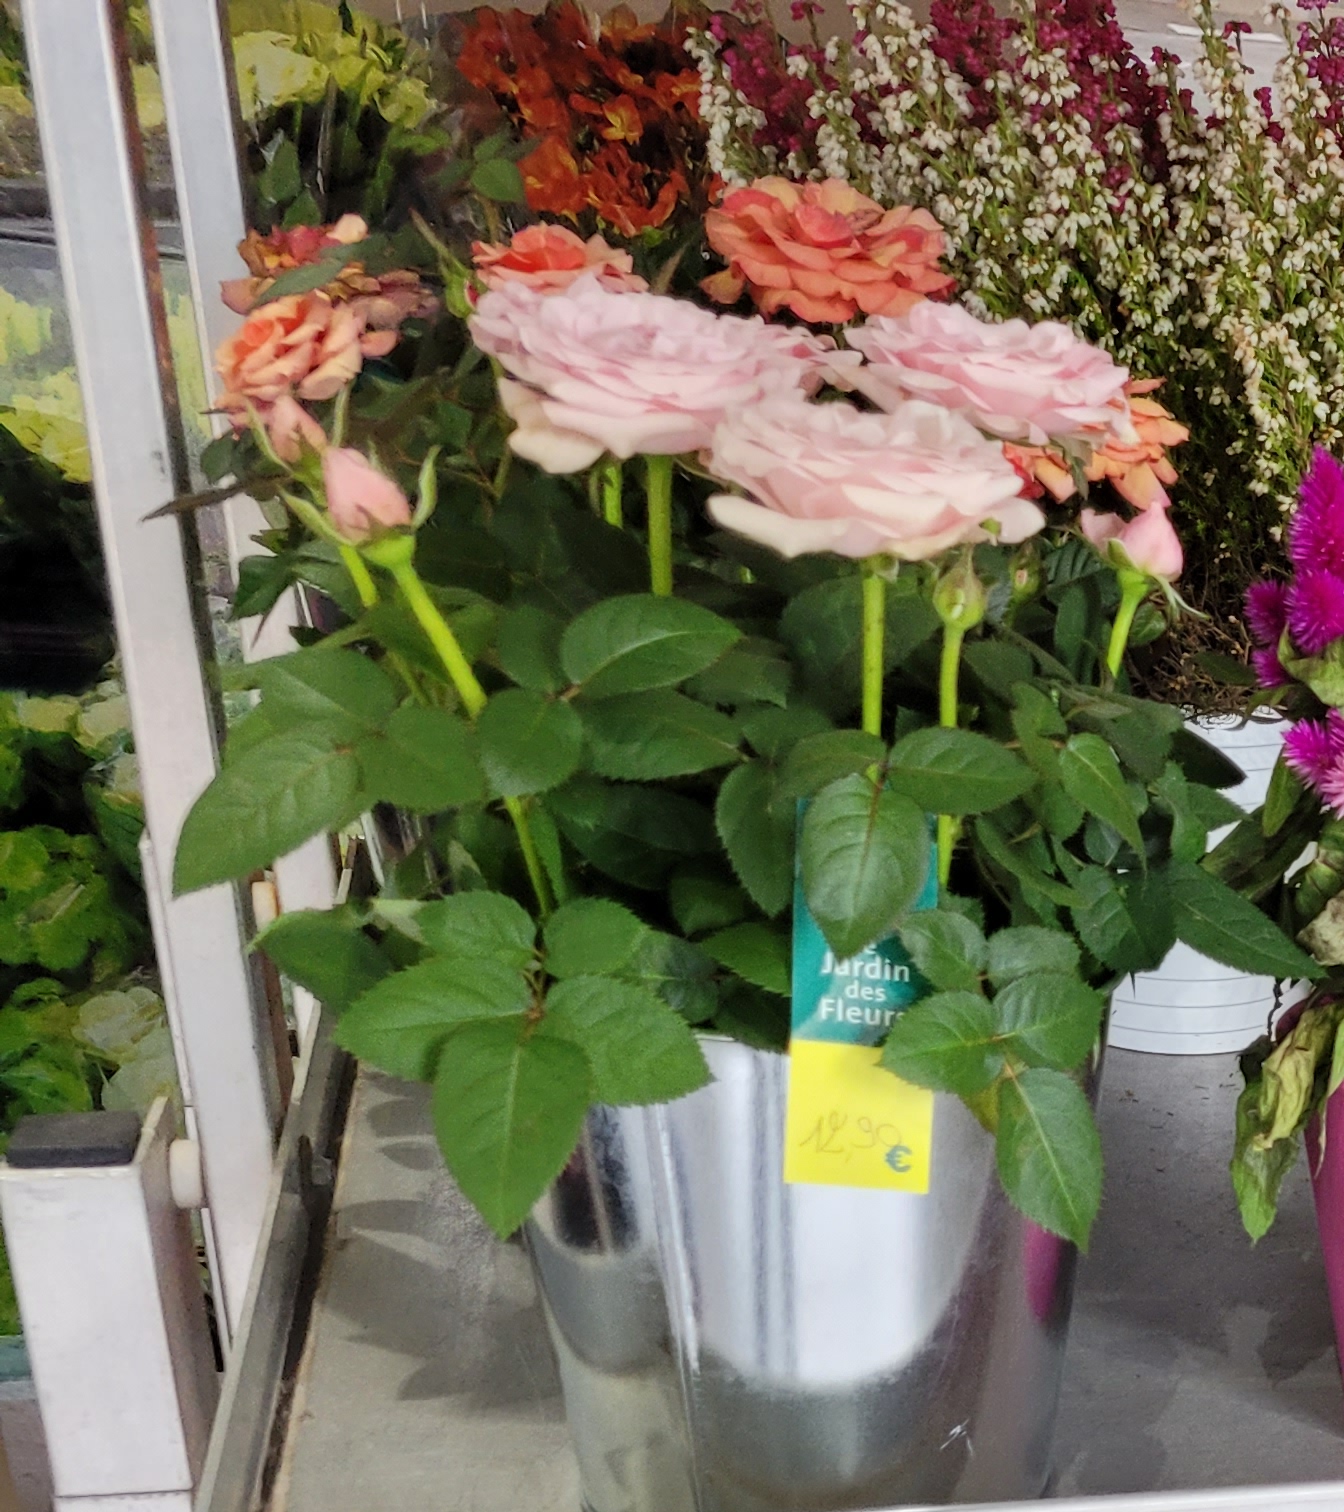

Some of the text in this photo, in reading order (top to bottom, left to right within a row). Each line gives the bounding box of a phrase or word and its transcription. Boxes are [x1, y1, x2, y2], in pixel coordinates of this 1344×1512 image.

[820, 953, 911, 983] Jardin
[845, 980, 887, 1002] des
[884, 1144, 914, 1174] €
